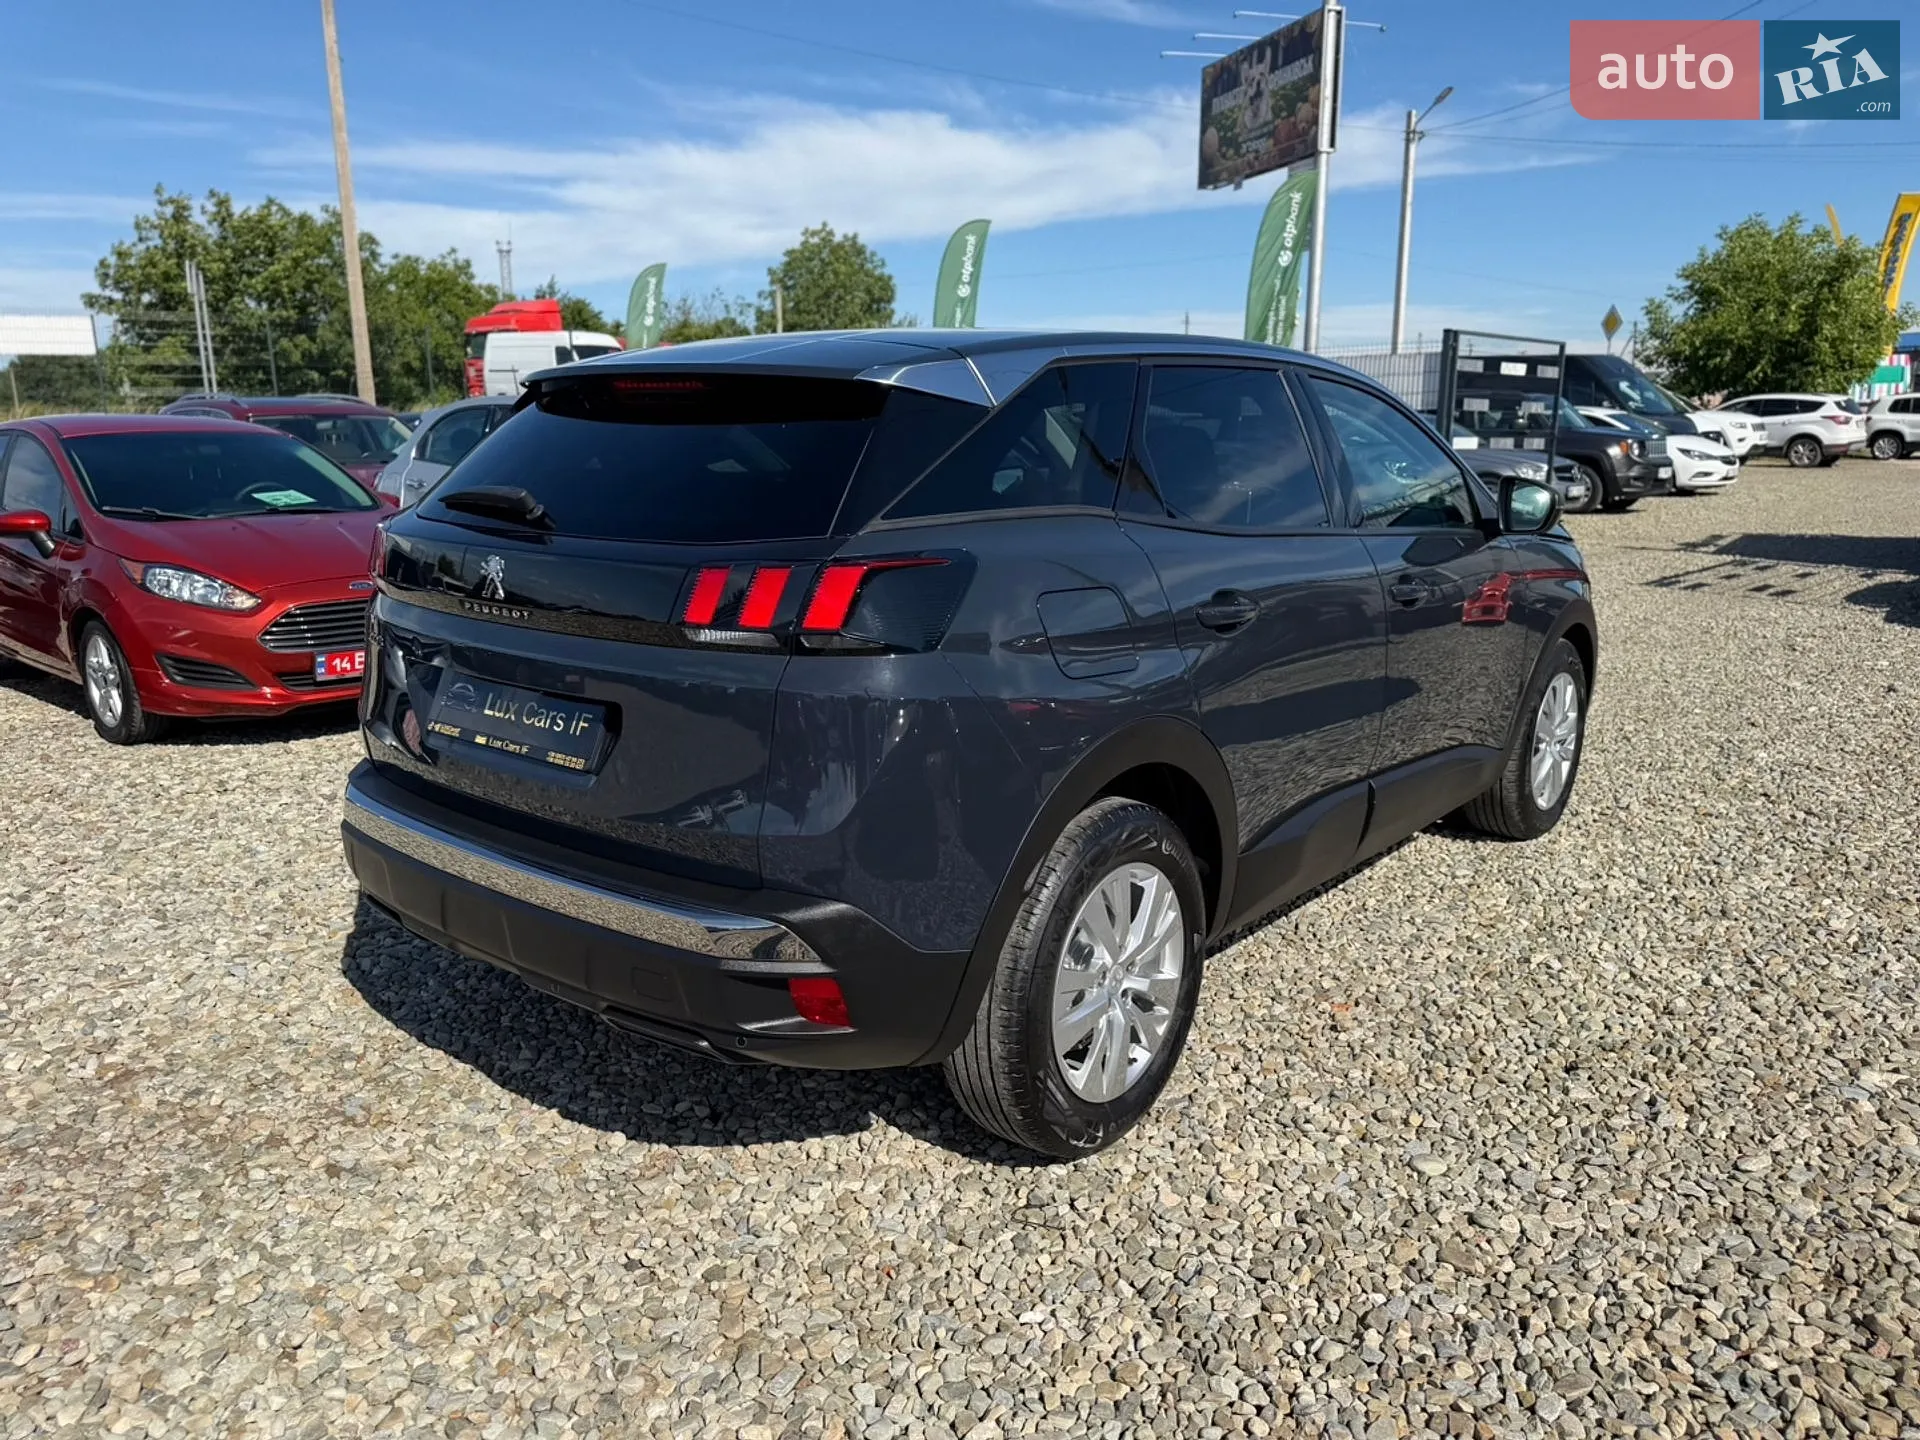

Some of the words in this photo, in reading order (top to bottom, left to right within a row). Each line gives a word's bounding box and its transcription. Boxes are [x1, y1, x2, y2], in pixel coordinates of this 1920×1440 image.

[1284, 192, 1302, 247] otpbank
[464, 601, 530, 620] PEUGEOT
[331, 655, 350, 671] 14
[483, 692, 518, 721] Lux
[522, 702, 566, 731] Cars
[570, 712, 593, 736] IF
